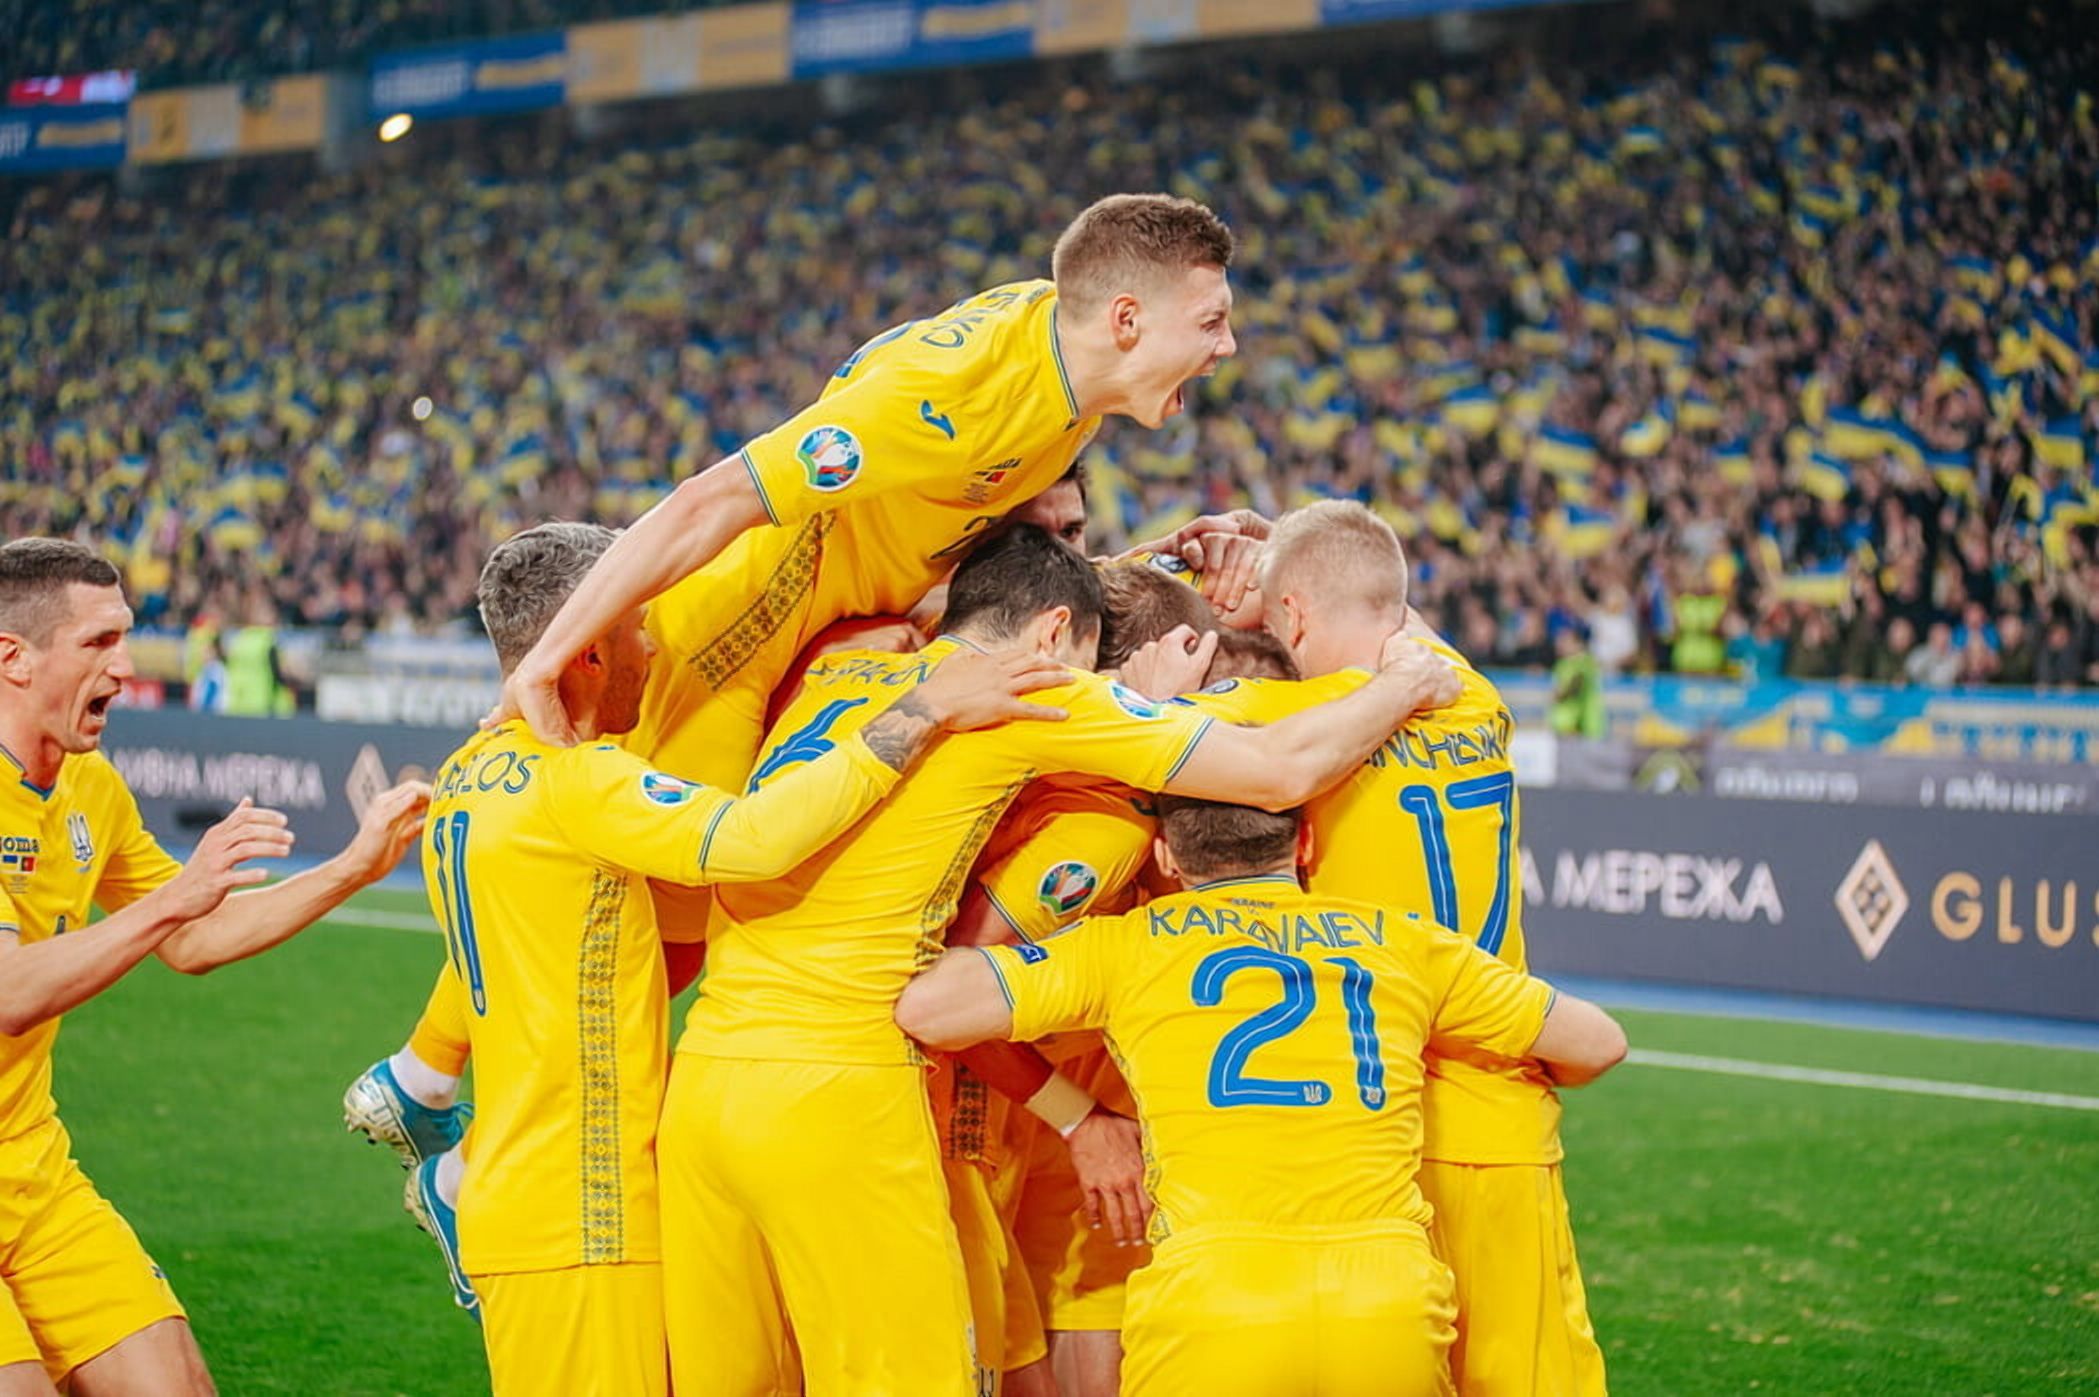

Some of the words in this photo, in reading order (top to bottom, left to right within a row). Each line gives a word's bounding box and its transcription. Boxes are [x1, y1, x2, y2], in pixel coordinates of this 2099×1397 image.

[0, 836, 40, 853] oma
[1400, 771, 1513, 956] 17
[433, 811, 486, 1016] 11
[1551, 848, 1783, 924] МЕРЕЖА
[1932, 871, 2099, 948] GLU
[1149, 905, 1383, 954] KARAVAIEV
[1191, 945, 1386, 1110] 21
